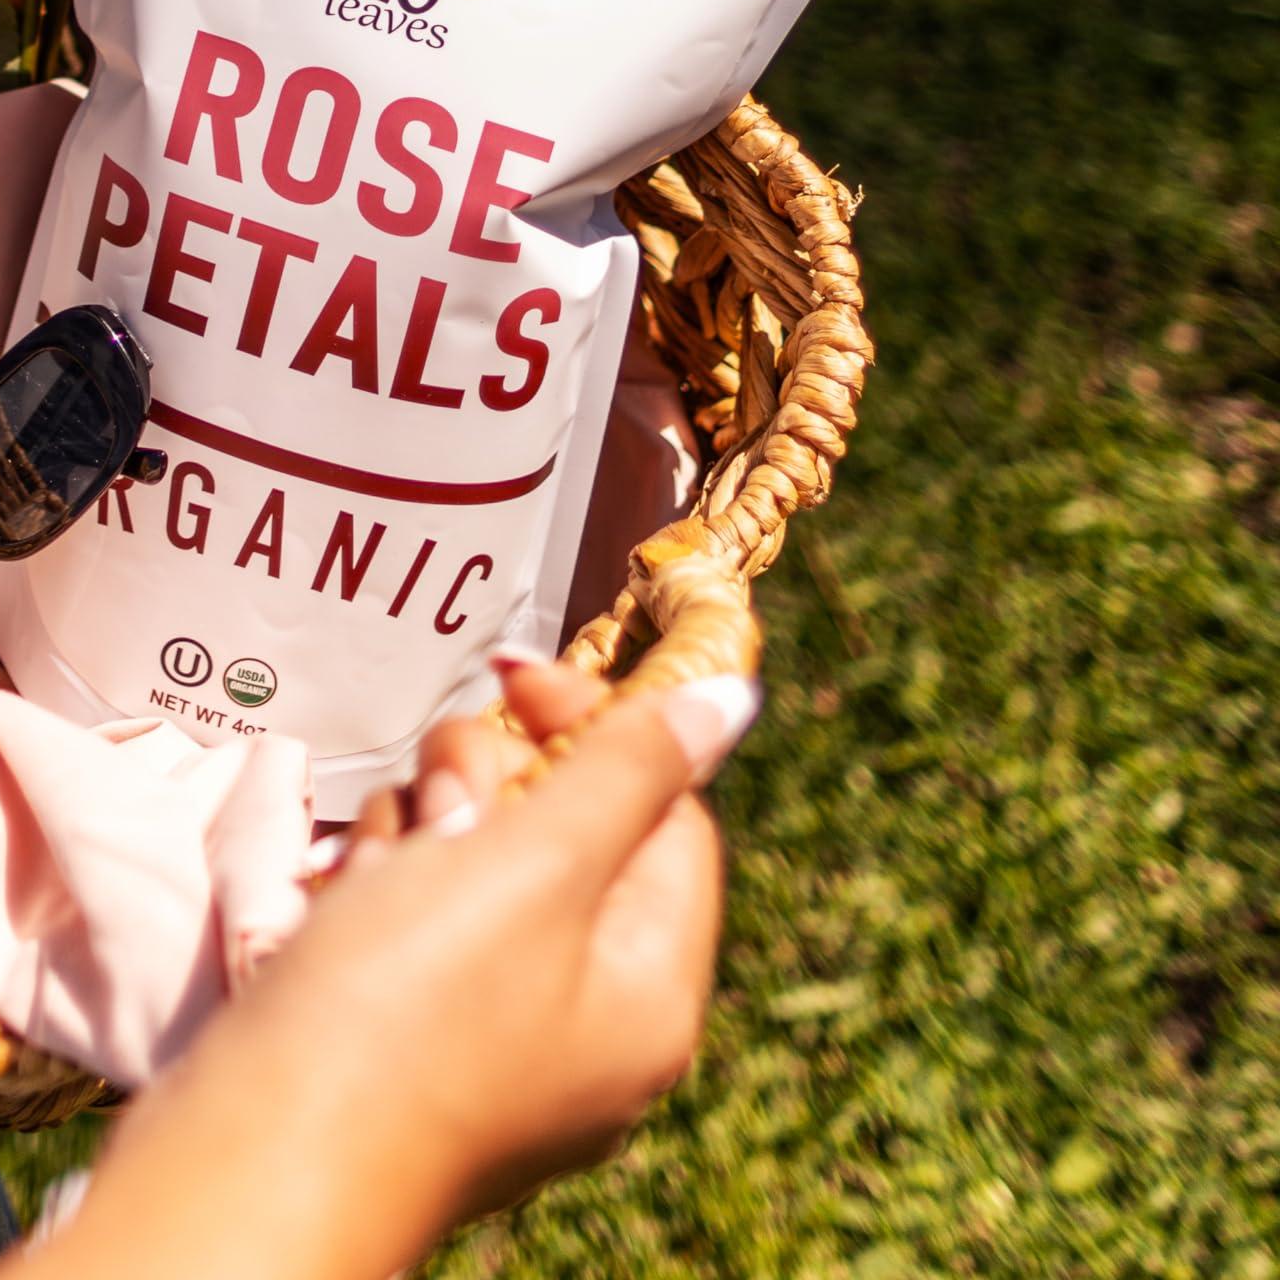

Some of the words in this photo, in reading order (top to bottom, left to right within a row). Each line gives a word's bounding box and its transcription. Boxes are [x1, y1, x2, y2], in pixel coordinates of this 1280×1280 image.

[163, 30, 556, 264] ROSE
[76, 153, 562, 412] PETALS
[96, 461, 494, 636] RGANIC
[149, 688, 191, 715] NET
[196, 704, 228, 729] WT
[229, 679, 269, 698] ORGANIC
[237, 667, 266, 684] USDA
